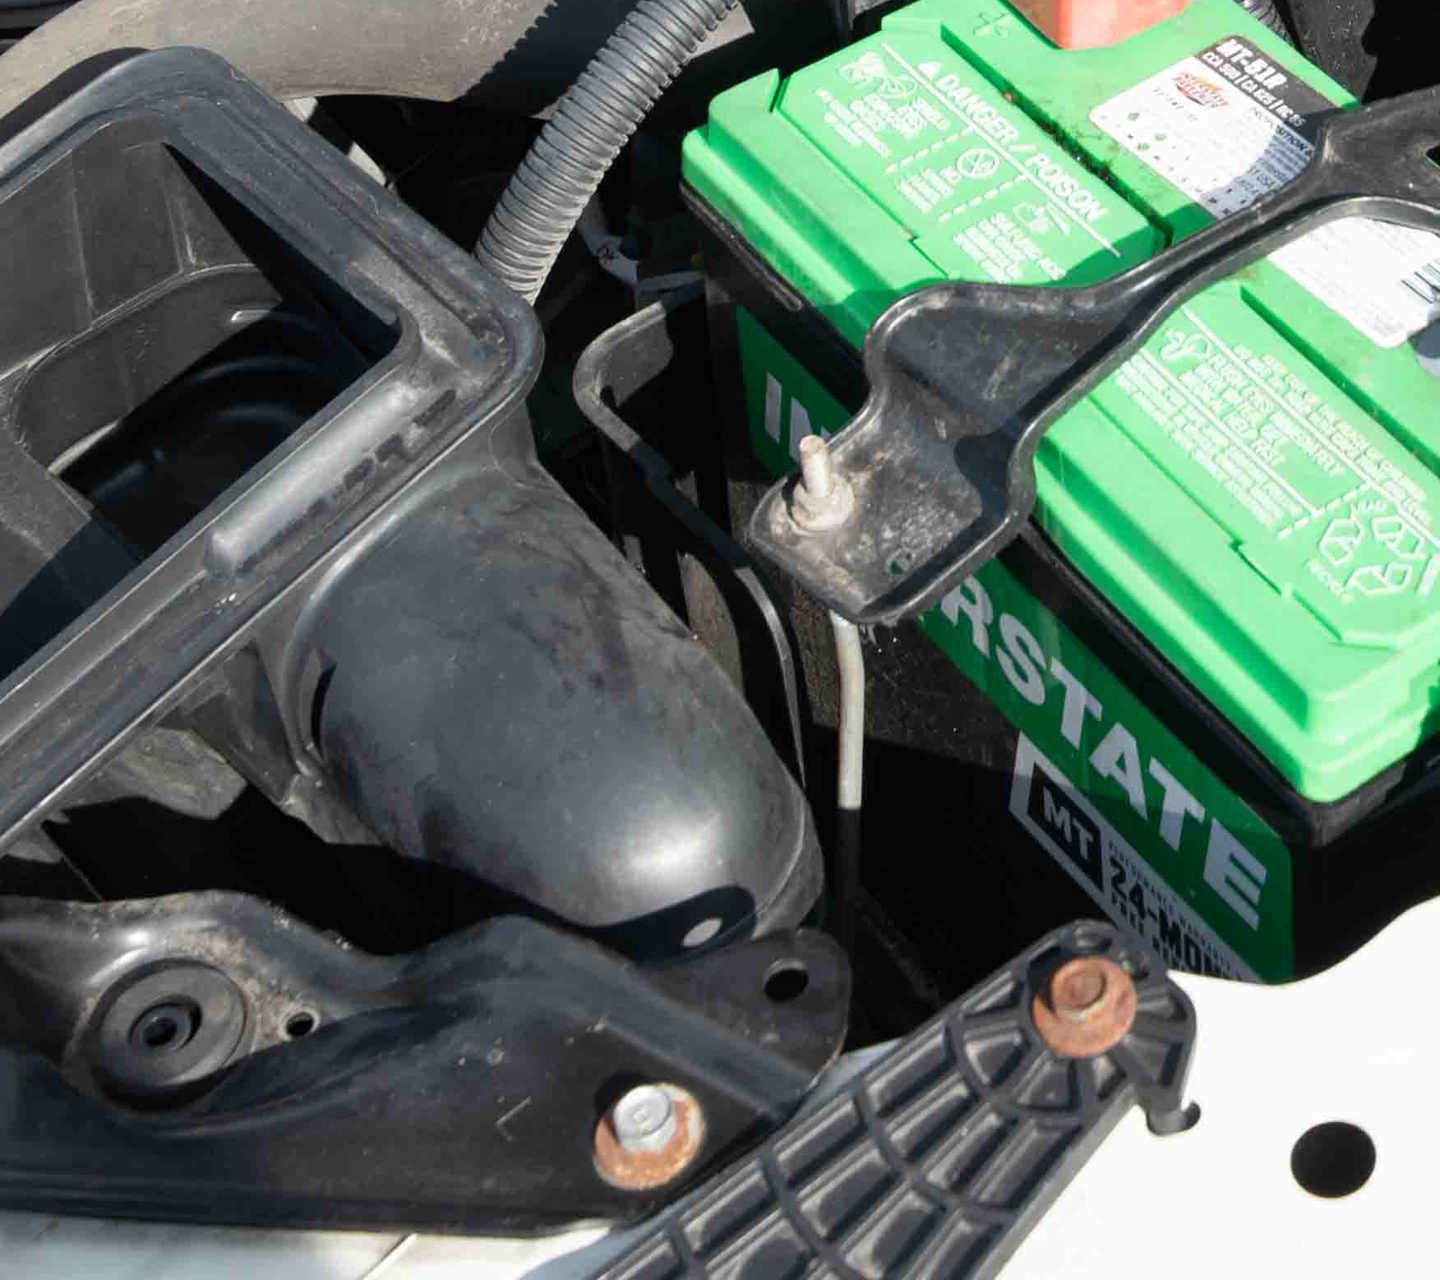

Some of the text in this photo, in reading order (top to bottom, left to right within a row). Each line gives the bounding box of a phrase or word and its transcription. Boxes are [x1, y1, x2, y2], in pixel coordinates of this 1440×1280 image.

[1216, 38, 1288, 90] MT-51R
[936, 74, 1019, 144] DANGER
[1024, 153, 1110, 222] POISON
[1044, 784, 1097, 861] MT
